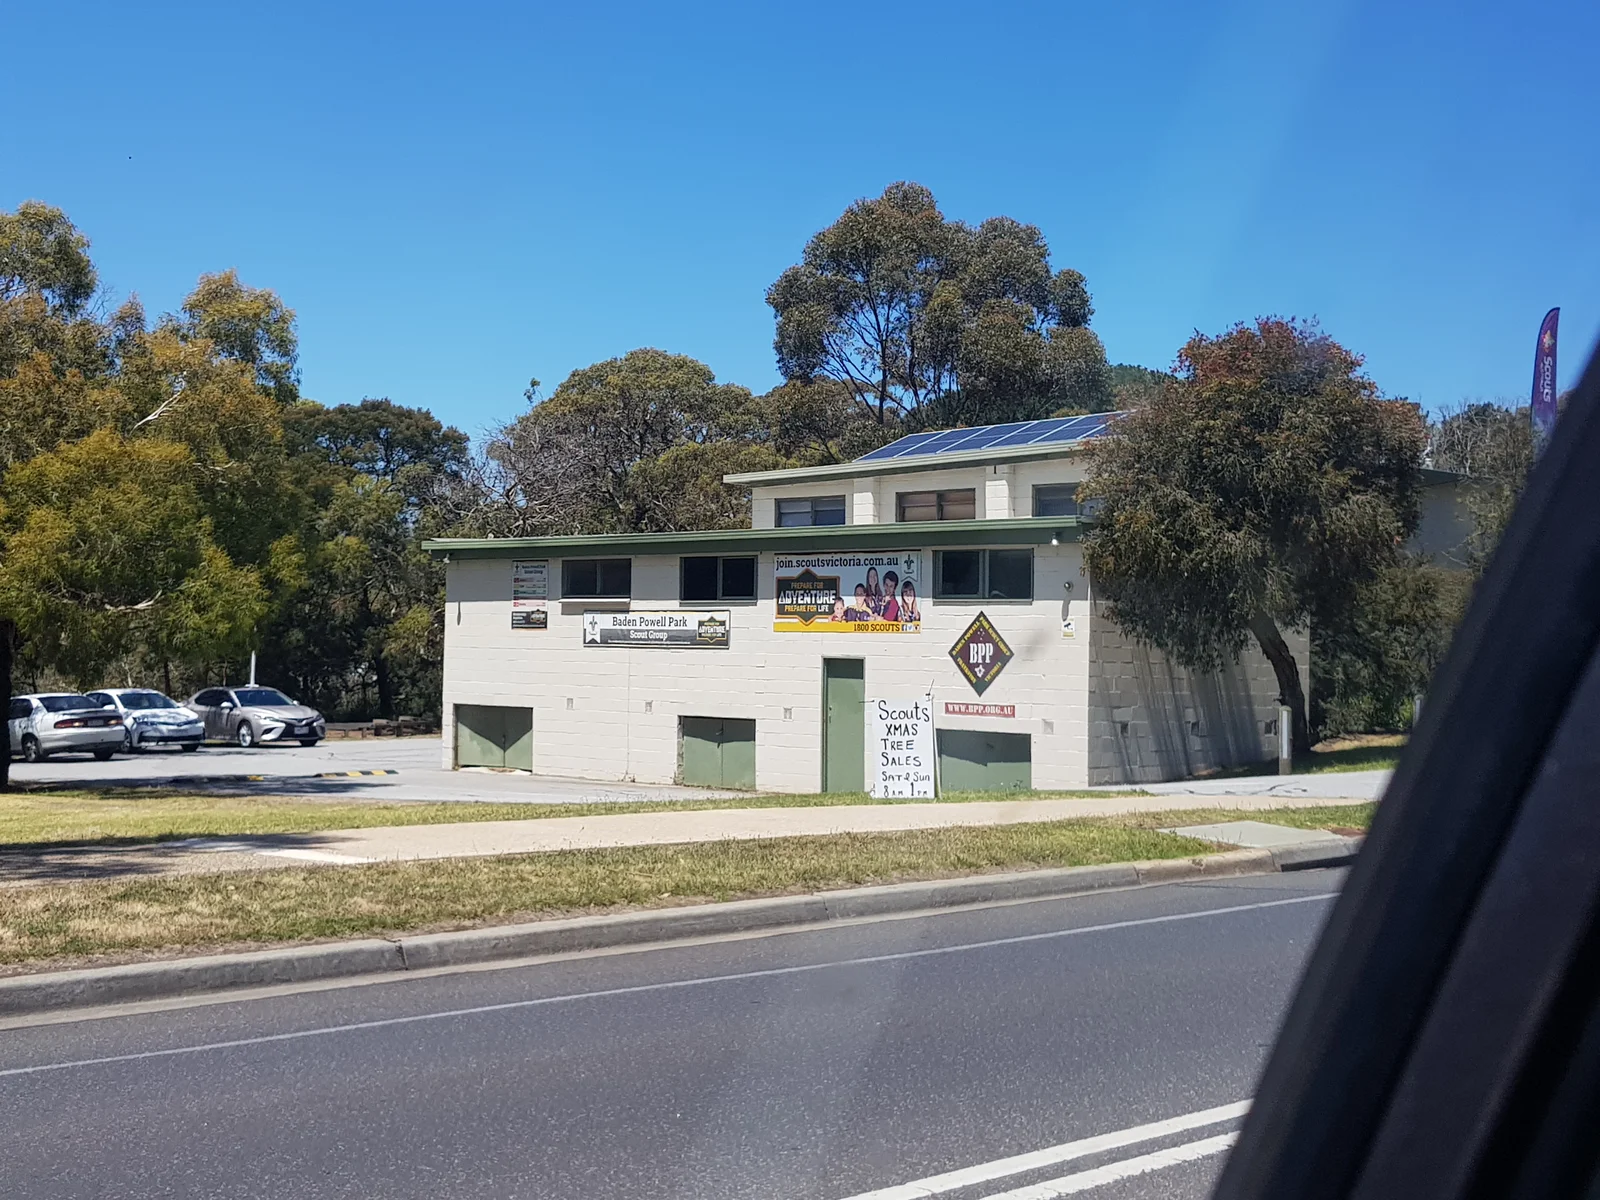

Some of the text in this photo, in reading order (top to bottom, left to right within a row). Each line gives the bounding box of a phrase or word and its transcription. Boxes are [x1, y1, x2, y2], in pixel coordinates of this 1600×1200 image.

[1543, 356, 1553, 403] Scouts
[776, 555, 898, 571] join.scoutsvictoria.com.au
[778, 590, 836, 604] ADVENTURE
[612, 616, 688, 627] Baden Powell Park
[854, 623, 900, 632] 1800 SCOUTS
[630, 630, 668, 641] Scout Group
[969, 642, 994, 663] BPP
[878, 699, 930, 722] Scouts
[947, 703, 1014, 715] WWW.BPP.ORG.AU
[885, 723, 918, 736] XMAS
[880, 738, 915, 751] TREE
[881, 751, 922, 767] SALES
